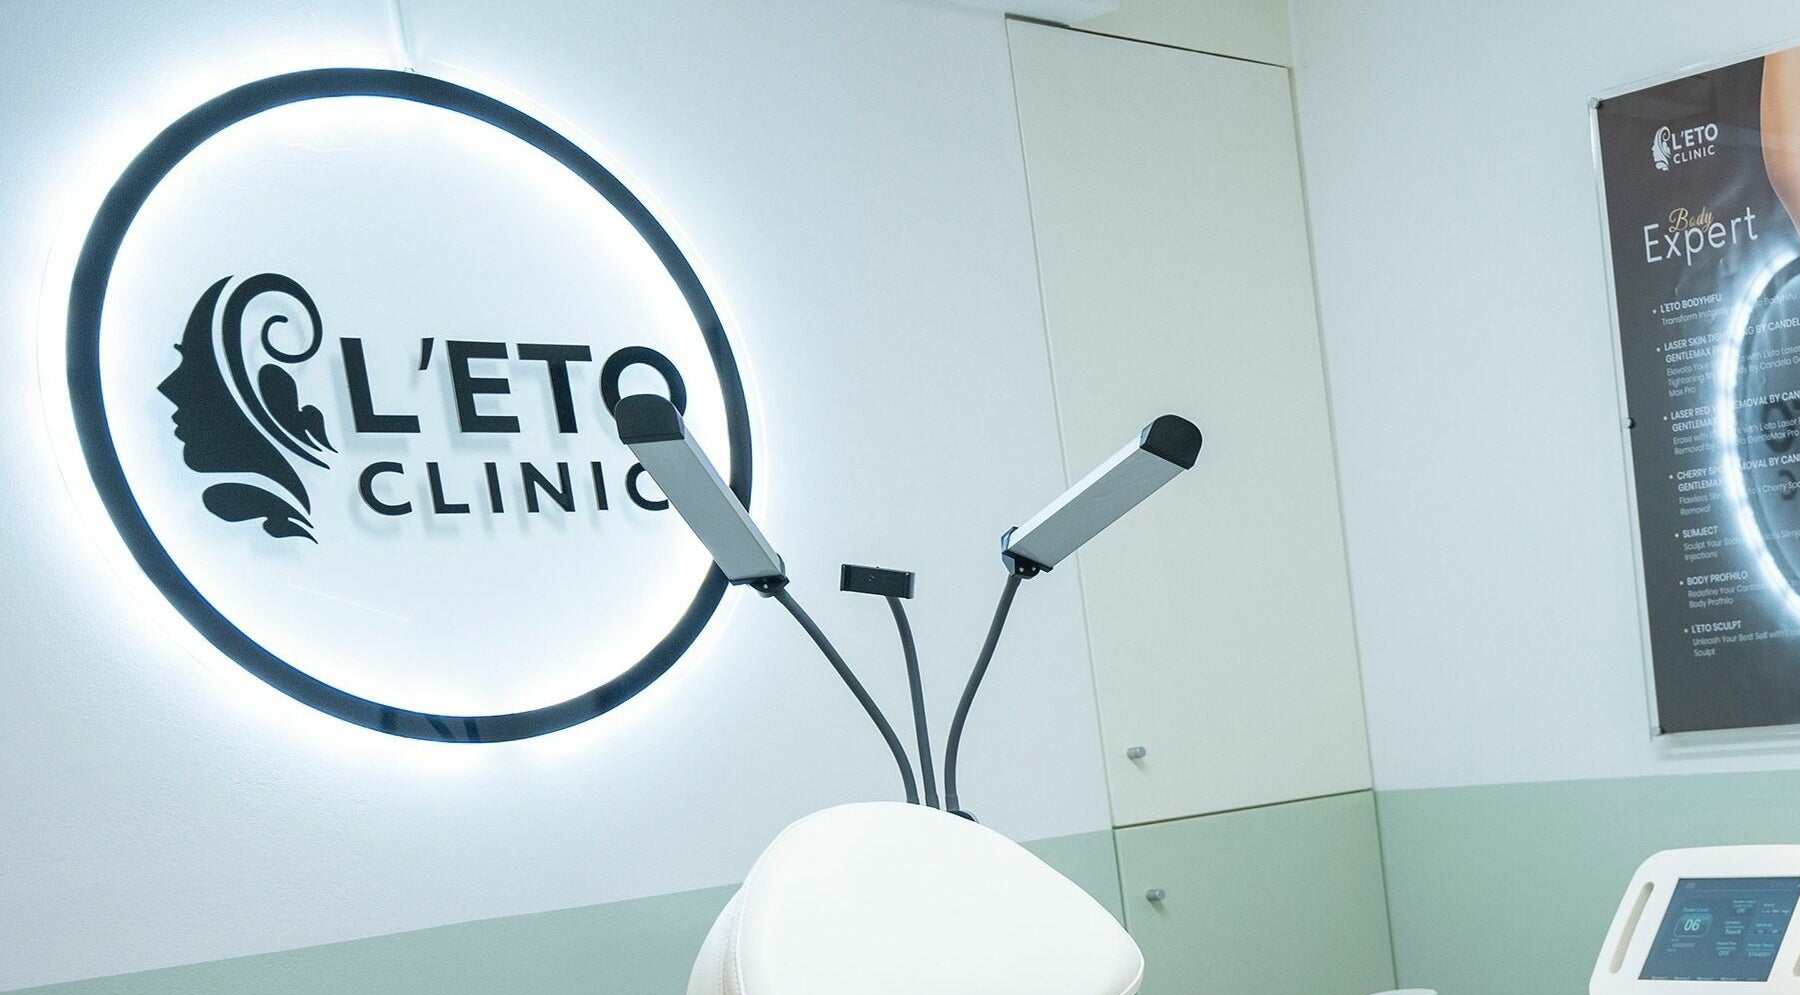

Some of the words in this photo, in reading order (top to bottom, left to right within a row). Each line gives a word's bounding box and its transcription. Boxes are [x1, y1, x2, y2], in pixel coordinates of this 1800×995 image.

[1672, 124, 1718, 150] L'ETO
[1673, 145, 1716, 164] CLINIC
[1668, 206, 1714, 232] Body
[1644, 207, 1758, 266] Expert
[1664, 340, 1687, 352] LASER
[1756, 324, 1766, 334] BY
[339, 336, 687, 434] L'ETO
[1670, 408, 1694, 420] LASER
[1736, 398, 1769, 410] EMOVAL
[1770, 394, 1781, 404] BY
[1778, 418, 1798, 429] Laser
[1787, 430, 1800, 438] Pro
[1676, 468, 1707, 480] CHERRY
[1769, 457, 1780, 467] BY
[358, 461, 669, 516] CLINIC
[1686, 574, 1710, 586] BODY
[1710, 570, 1748, 584] PROFHILO
[1713, 620, 1742, 632] SCULPT
[1684, 918, 1702, 932] 06
